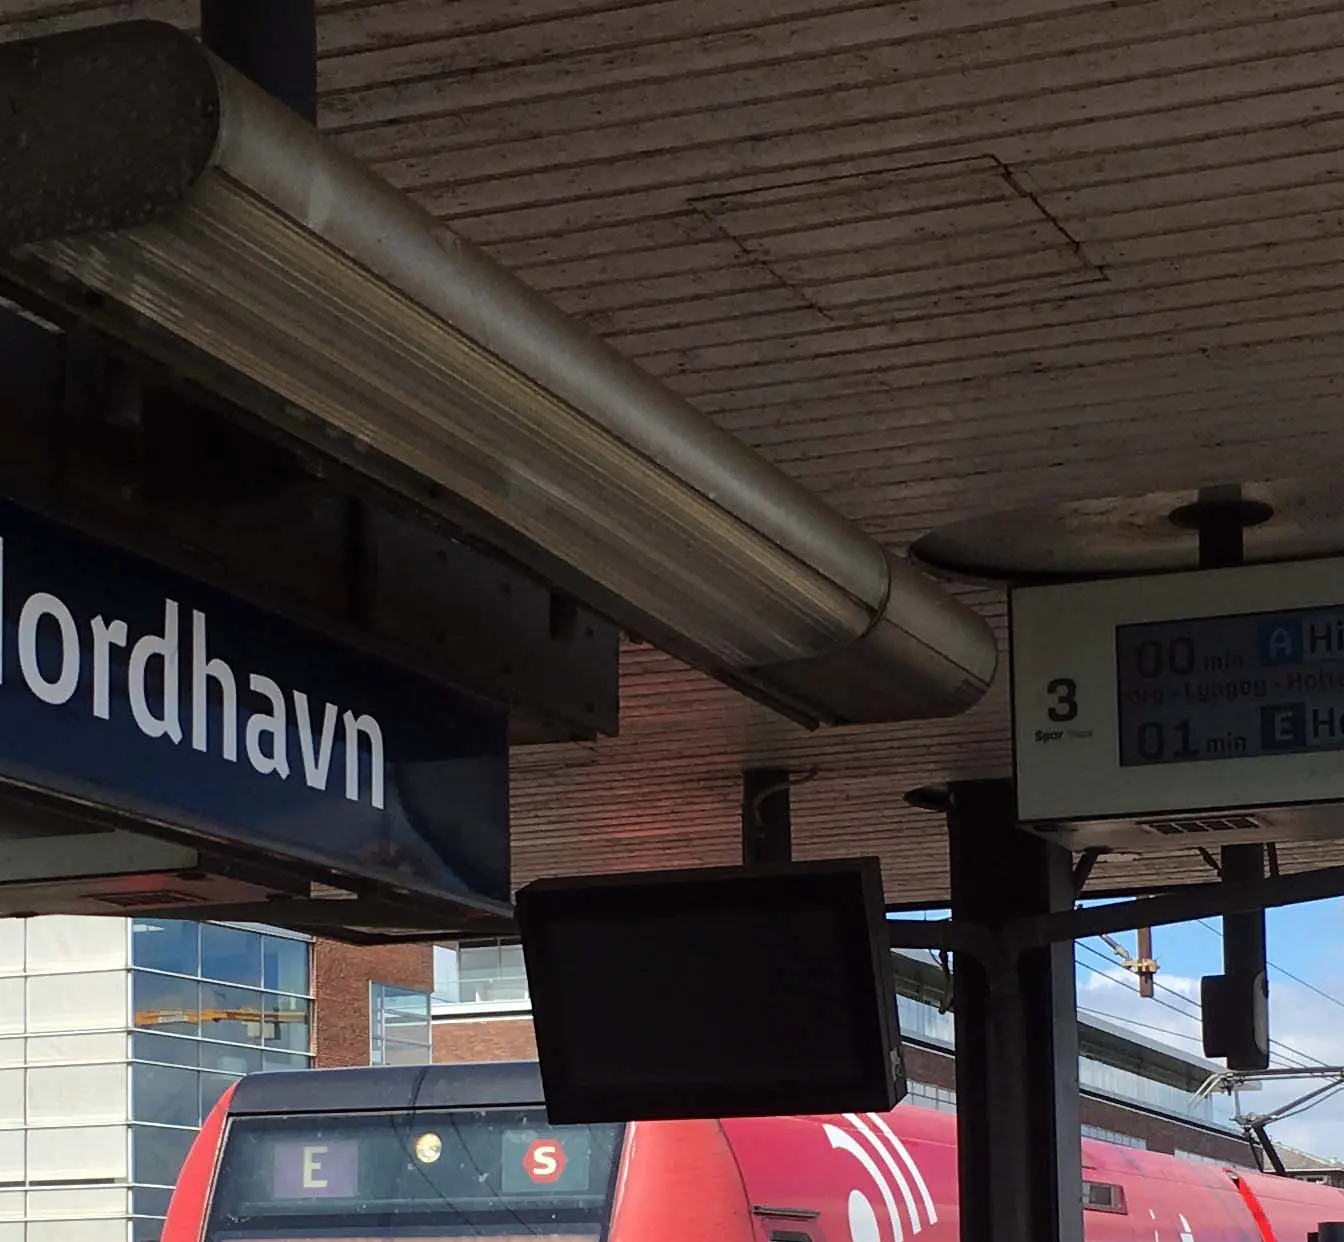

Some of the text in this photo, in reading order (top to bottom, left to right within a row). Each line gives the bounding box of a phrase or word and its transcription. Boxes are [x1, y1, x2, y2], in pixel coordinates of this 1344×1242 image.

[1134, 636, 1196, 679] 00
[1203, 649, 1244, 673] min
[1268, 626, 1293, 660] A
[1046, 677, 1078, 723] 3
[1136, 717, 1199, 761] 01
[1206, 731, 1247, 753] min
[1273, 709, 1296, 743] E
[303, 1145, 329, 1188] E
[532, 1145, 558, 1176] S
